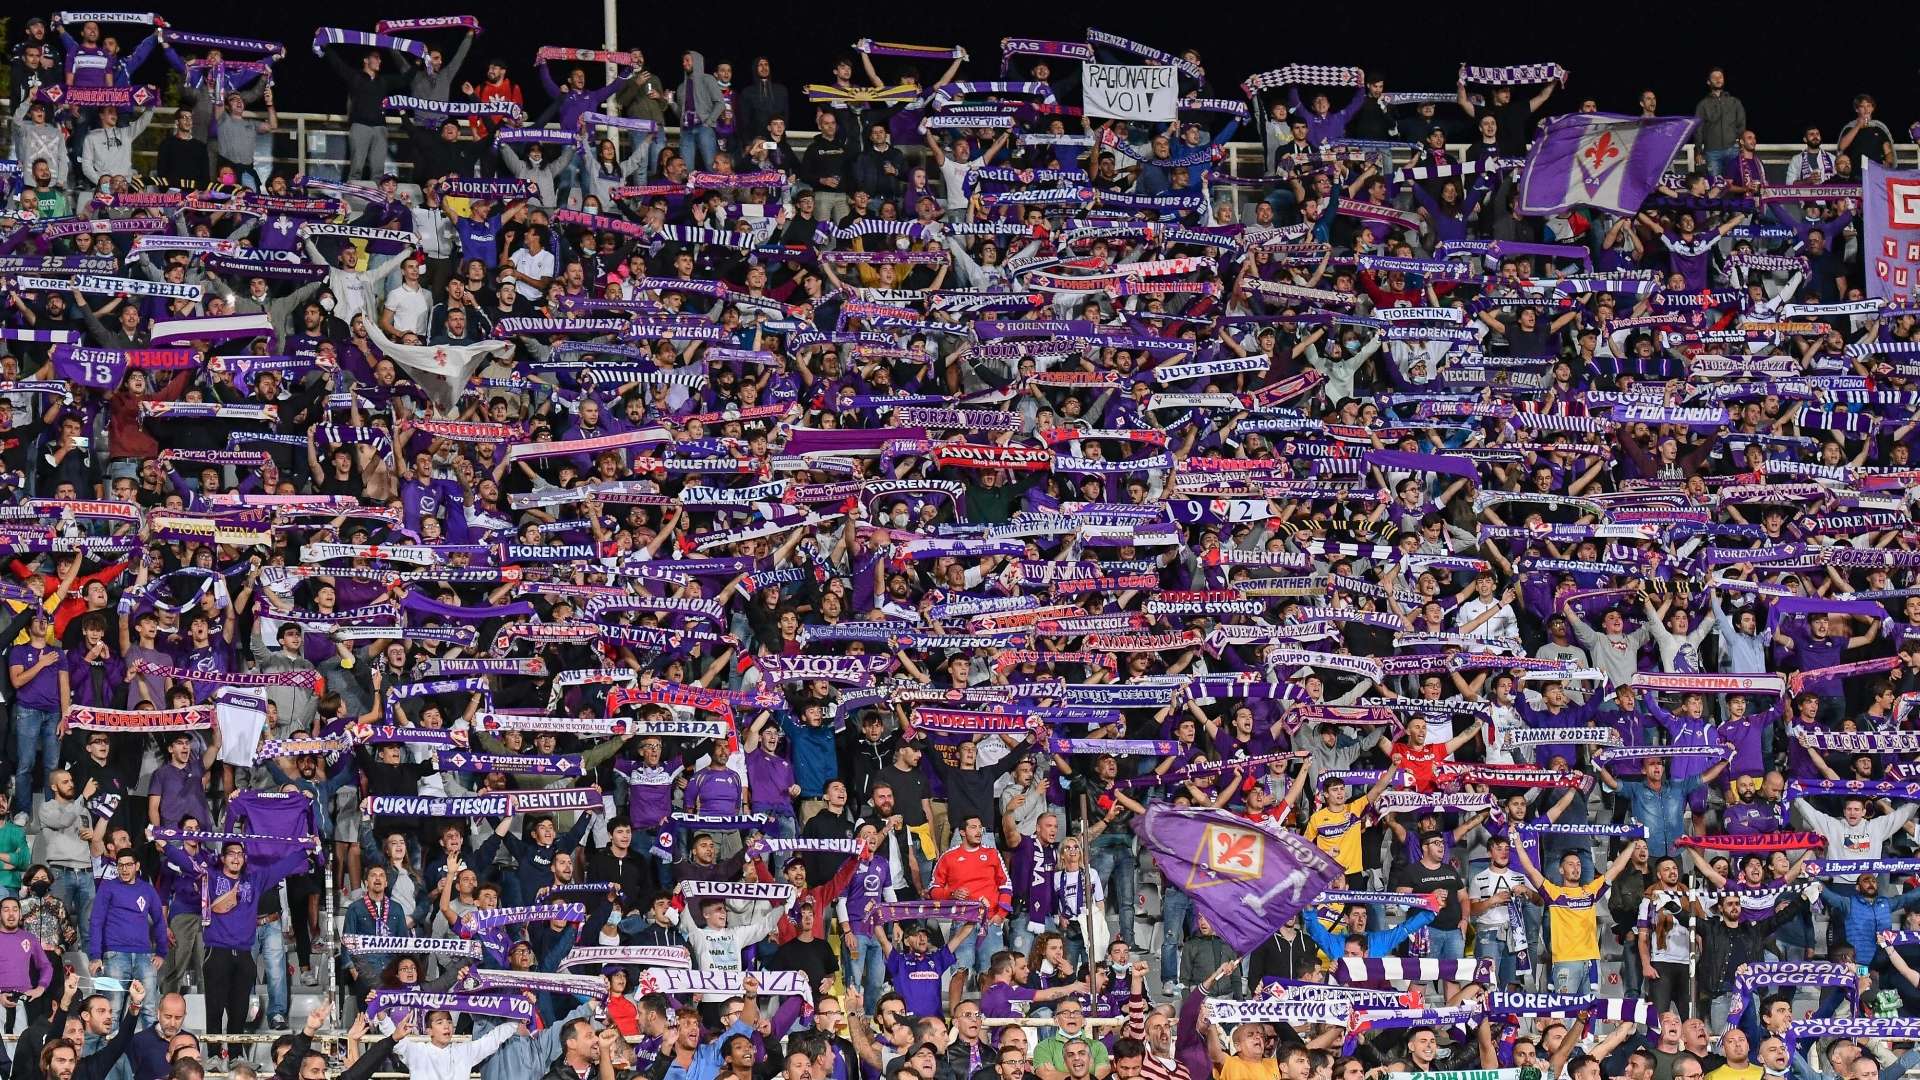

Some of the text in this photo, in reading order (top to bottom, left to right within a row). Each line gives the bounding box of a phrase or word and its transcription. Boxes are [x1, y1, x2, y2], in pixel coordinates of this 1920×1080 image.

[72, 12, 141, 22] FIORENTINA
[418, 16, 461, 26] COSTA
[1130, 41, 1157, 62] VANTO
[1162, 52, 1170, 62] E
[1089, 64, 1172, 89] RAGIONATECI
[389, 95, 513, 114] UNONOVEDUESEI
[452, 181, 526, 194] FIORENTINA
[1772, 187, 1858, 196] VIOLA FOREVER
[999, 188, 1076, 202] FIORENTINA
[559, 210, 592, 225] JUVE
[308, 223, 413, 243] FIORENTINA
[952, 223, 1034, 235] FIORENTINA
[1067, 228, 1144, 238] FIORENTINA
[145, 239, 212, 249] FIORENTINA
[1179, 231, 1238, 249] FIORENTINA
[41, 256, 113, 269] 25 2003
[291, 266, 312, 274] VIOLA
[73, 274, 199, 299] SETTE BELLO
[641, 276, 714, 293] Fiorentina
[1054, 279, 1121, 289] FIORENTINA
[945, 295, 1029, 306] FIORENTINA
[1383, 308, 1452, 319] FIORENTINA
[1792, 302, 1879, 314] FIORENTINA
[630, 325, 719, 339] JUVE MERDA
[1007, 322, 1070, 331] FIORENTINA
[1388, 328, 1473, 341] ACF FIORENTINA
[1710, 329, 1746, 339] GALLO
[1138, 339, 1191, 351] FIESOLE
[70, 350, 120, 364] ASTORI
[1461, 357, 1481, 365] ACF
[253, 359, 311, 369] Fiorentina
[1159, 357, 1267, 380] JUVE MERDA
[1705, 360, 1788, 372] FORZA RAGAZZI
[81, 363, 112, 384] 13
[1041, 371, 1104, 383] FIORENTINA
[909, 410, 1011, 428] FORZA VIOLA
[1626, 404, 1722, 422] AVANTI VIOLA
[425, 424, 510, 438] FIORENTINA
[1236, 419, 1323, 433] ACF FIORENTINA
[172, 448, 261, 461] Forza Fiorentina
[664, 458, 737, 470] COLLETTIVO
[1056, 458, 1102, 470] FORZA
[1119, 456, 1169, 469] CUORE
[1765, 461, 1844, 480] FIORENTINA
[684, 486, 730, 501] JUVE
[795, 484, 825, 496] Forza
[867, 479, 964, 499] FIORENTINA
[52, 502, 131, 516] FIORENTINA
[1816, 512, 1905, 530] FIORENTINA
[168, 521, 260, 539] FIORENTINA
[52, 536, 112, 547] FIORENTINA
[322, 545, 424, 562] FORZA VIOLA
[509, 545, 594, 558] FIORENTINA
[1220, 549, 1306, 566] FIORENTINA
[1714, 546, 1776, 559] FIORENTINA
[1831, 552, 1886, 566] FORZA
[1025, 564, 1093, 579] FIORENTINA
[1535, 560, 1625, 573] ACF FIORENTINA
[1235, 578, 1271, 590] FROM
[1274, 578, 1312, 588] FATHER
[1147, 602, 1263, 615] GRUPPO STORICO
[1057, 617, 1130, 630] FIORENTINA
[1225, 623, 1320, 638] FORZA RAGAZZI
[916, 636, 1008, 649] FIORENTINA
[1558, 652, 1572, 661] NIKE
[440, 659, 519, 671] FORZA VIOLA
[782, 656, 866, 672] VIOLA
[1271, 653, 1379, 675] GRUPPO ANTIJUVE
[1384, 659, 1419, 671] Forza
[173, 667, 278, 684] FIORENTINA
[1658, 677, 1739, 689] FIORENTINA
[1361, 698, 1489, 712] ACF FIORENTINA
[95, 712, 185, 725] FIORENTINA
[922, 712, 1026, 731] FIORENTINA
[396, 728, 447, 738] Fiorentina
[645, 721, 721, 735] MERDA
[1514, 729, 1607, 742] FAMMI GODERE
[471, 755, 552, 766] A.C.FIORENTINA
[1389, 793, 1485, 806] FORZA RAGAZZI
[374, 797, 508, 816] CURVA FIESOLE
[1526, 823, 1622, 835] ACF FIORENTINA
[767, 839, 862, 854] FIORENTINA
[1825, 862, 1869, 873] Liberi di
[559, 883, 609, 891] FIORENTINA
[478, 903, 586, 921] DIRETTIVO
[527, 911, 557, 921] APRILE
[361, 936, 467, 951] FAMMI GODERE
[379, 993, 458, 1009] OVUNQUE
[468, 994, 495, 1008] CON
[1286, 986, 1399, 1009] FIORENTINA
[1238, 1002, 1326, 1016] COLLETTIVO
[1412, 1018, 1438, 1026] FIRENZE
